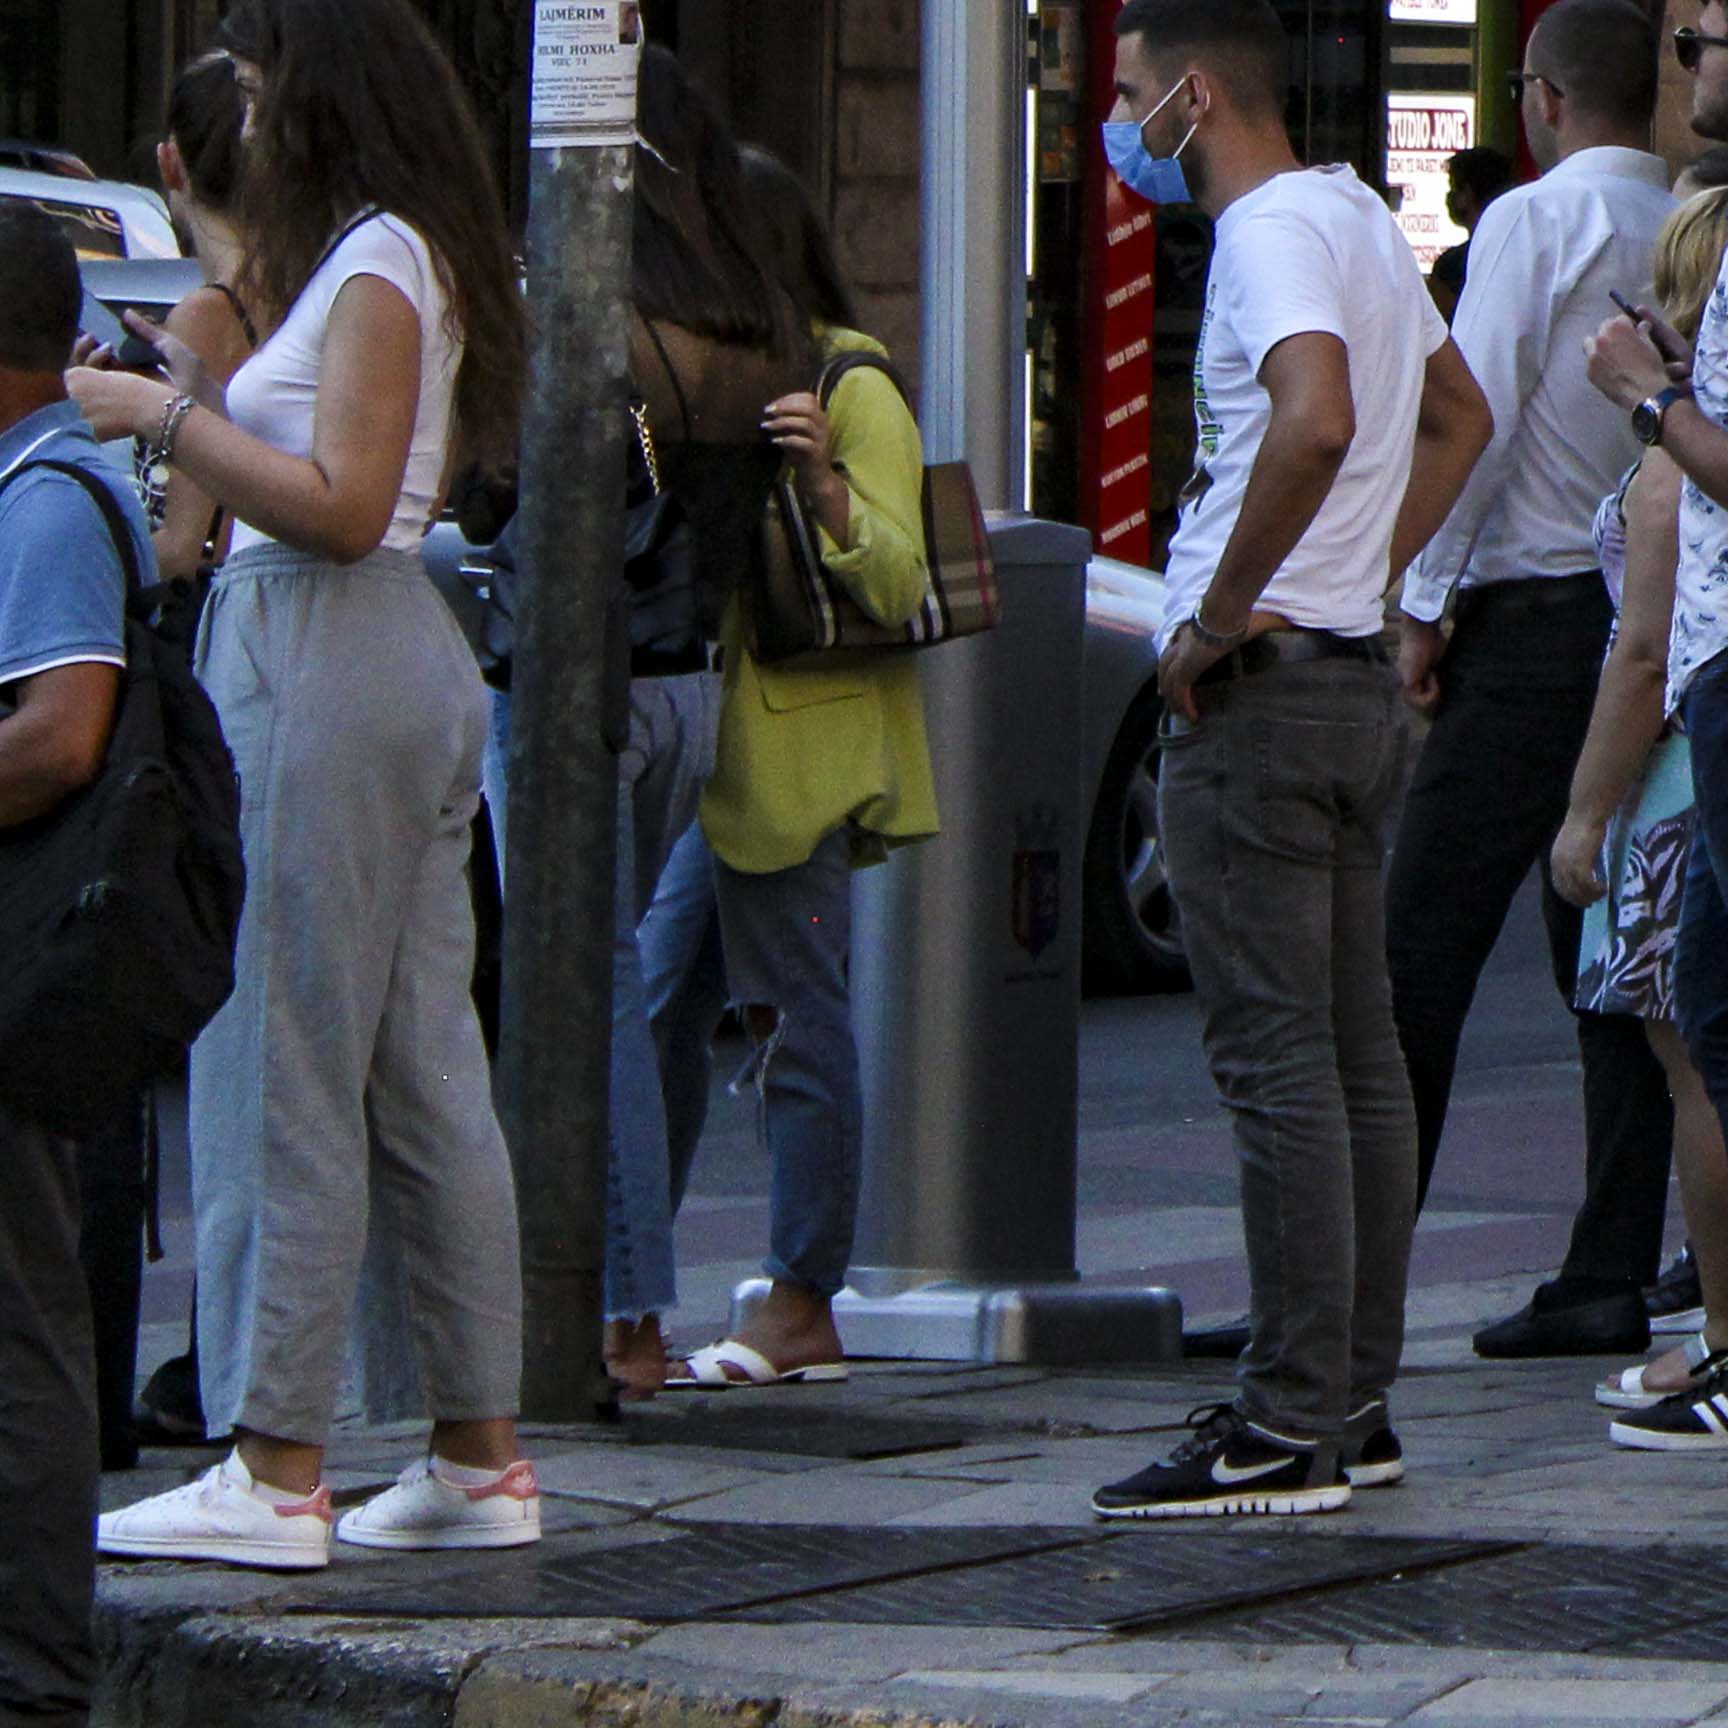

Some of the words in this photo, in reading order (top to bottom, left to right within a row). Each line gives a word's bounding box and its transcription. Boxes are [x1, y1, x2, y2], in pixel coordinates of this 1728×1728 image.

[540, 7, 605, 22] LAJMËRIM
[569, 44, 615, 56] HOXHA
[1388, 110, 1430, 150] TUDIO
